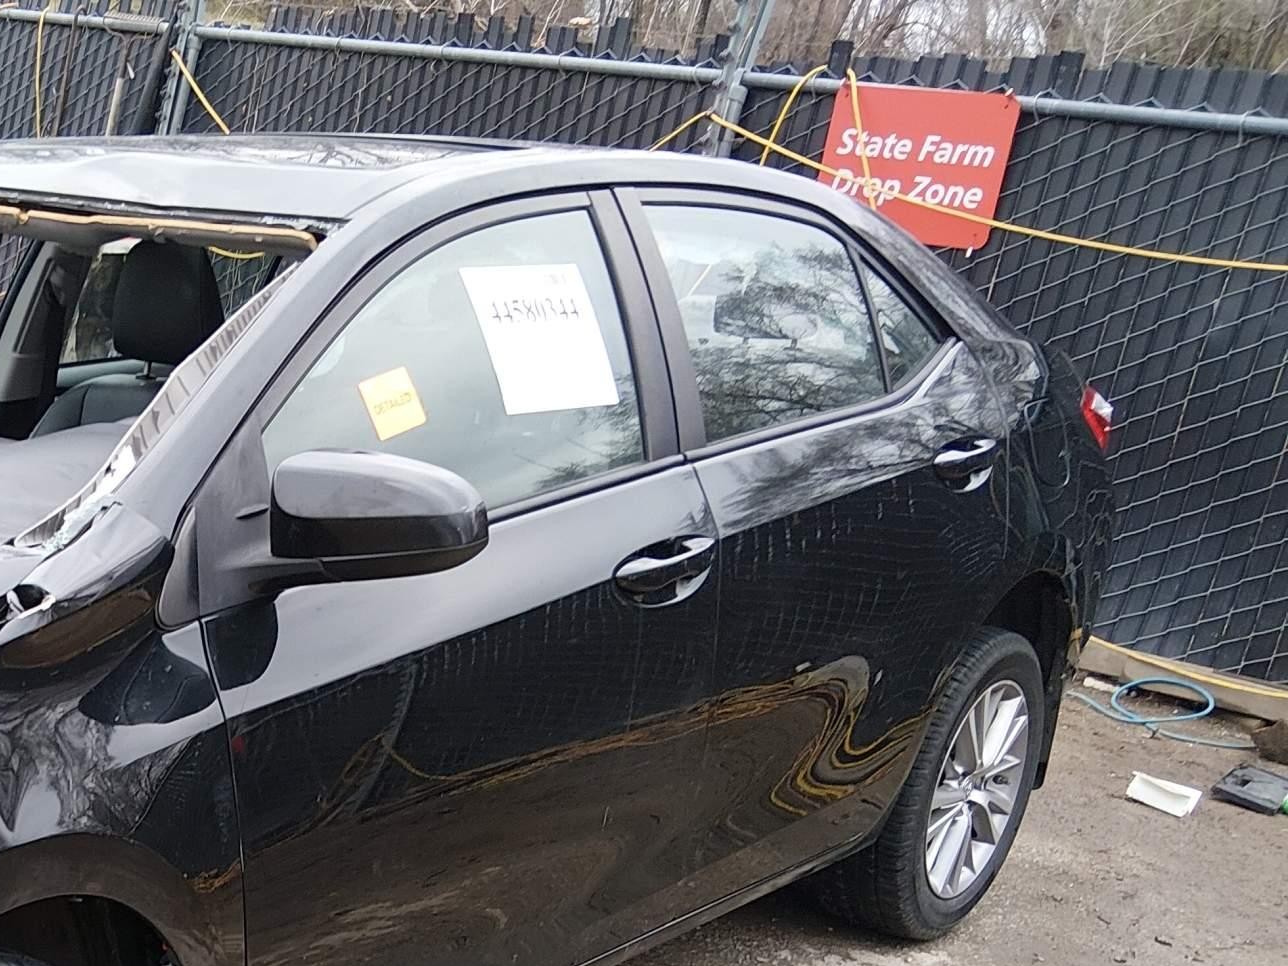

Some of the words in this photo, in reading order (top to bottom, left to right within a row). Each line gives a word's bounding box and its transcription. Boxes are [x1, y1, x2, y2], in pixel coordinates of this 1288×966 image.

[836, 127, 912, 160] State
[917, 134, 995, 168] Farm
[831, 168, 902, 206] Drop
[908, 175, 983, 209] Zone
